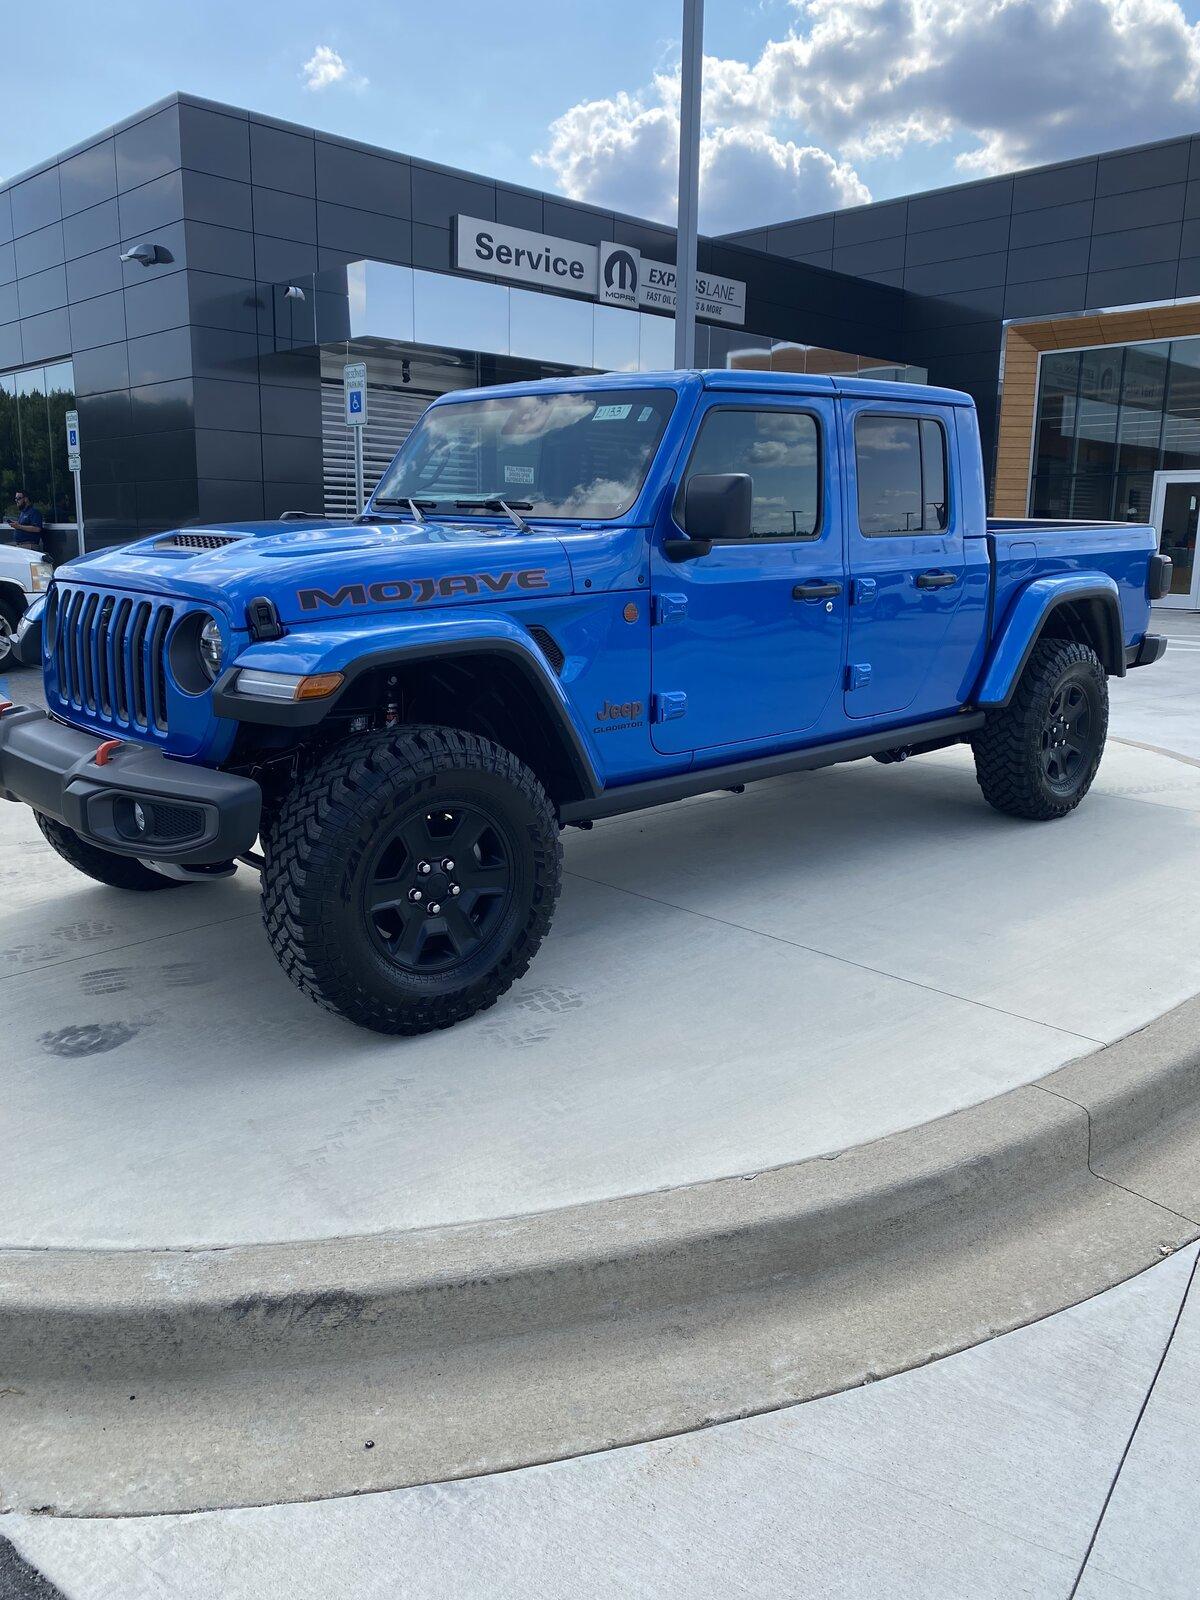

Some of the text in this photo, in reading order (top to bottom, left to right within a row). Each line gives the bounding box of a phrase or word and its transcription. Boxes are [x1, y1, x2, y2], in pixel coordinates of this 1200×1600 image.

[475, 232, 585, 280] Service
[605, 291, 636, 303] MOPAR
[646, 291, 661, 302] FAST
[662, 294, 672, 305] OIL
[706, 303, 722, 315] MORE
[297, 568, 550, 612] MOJAVE
[596, 700, 643, 721] Jeep
[593, 721, 643, 734] GLADIATOR
